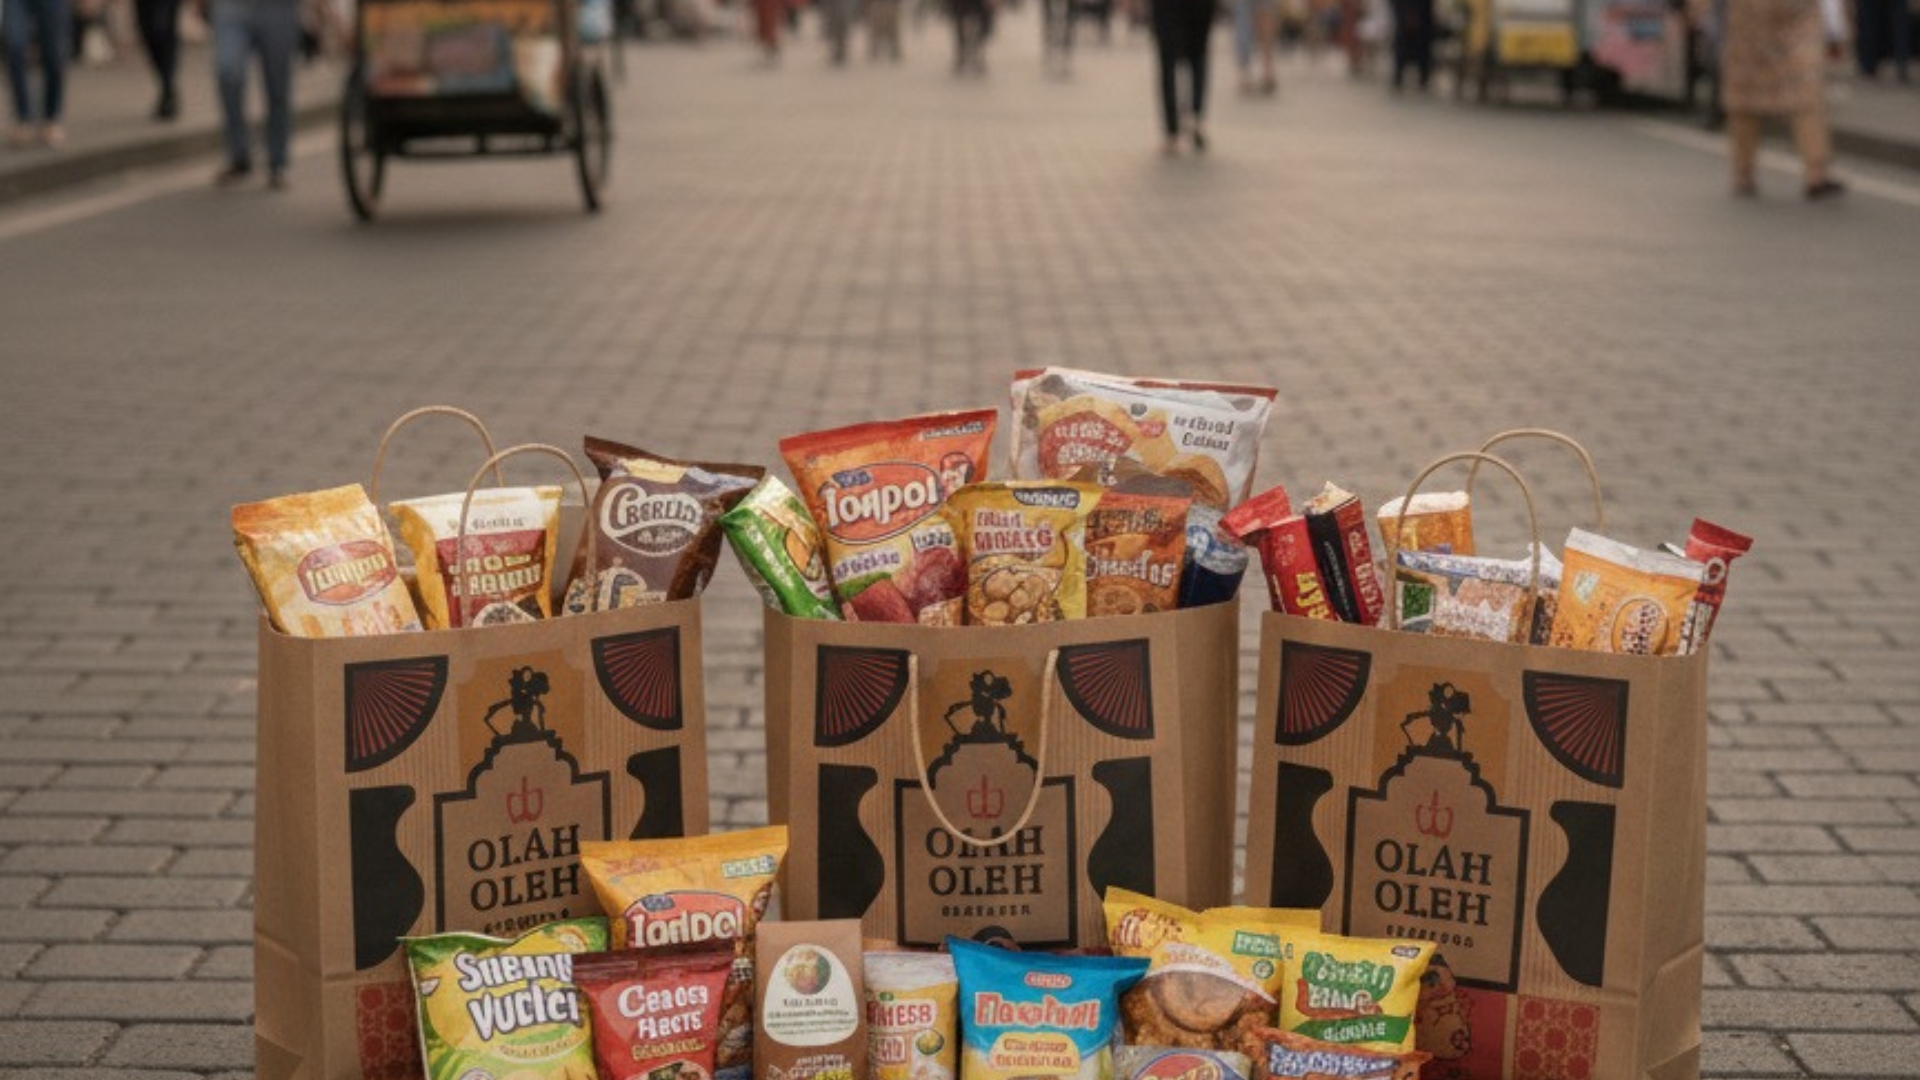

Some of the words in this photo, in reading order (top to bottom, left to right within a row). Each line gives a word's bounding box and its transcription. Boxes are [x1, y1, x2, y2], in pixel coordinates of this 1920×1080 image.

[468, 824, 580, 872] OLAH
[926, 826, 1044, 859] OLAH
[1375, 839, 1492, 886] OLAH
[470, 863, 580, 911] OLEH
[929, 864, 1044, 896] OLEH
[1375, 880, 1492, 926] OLEH
